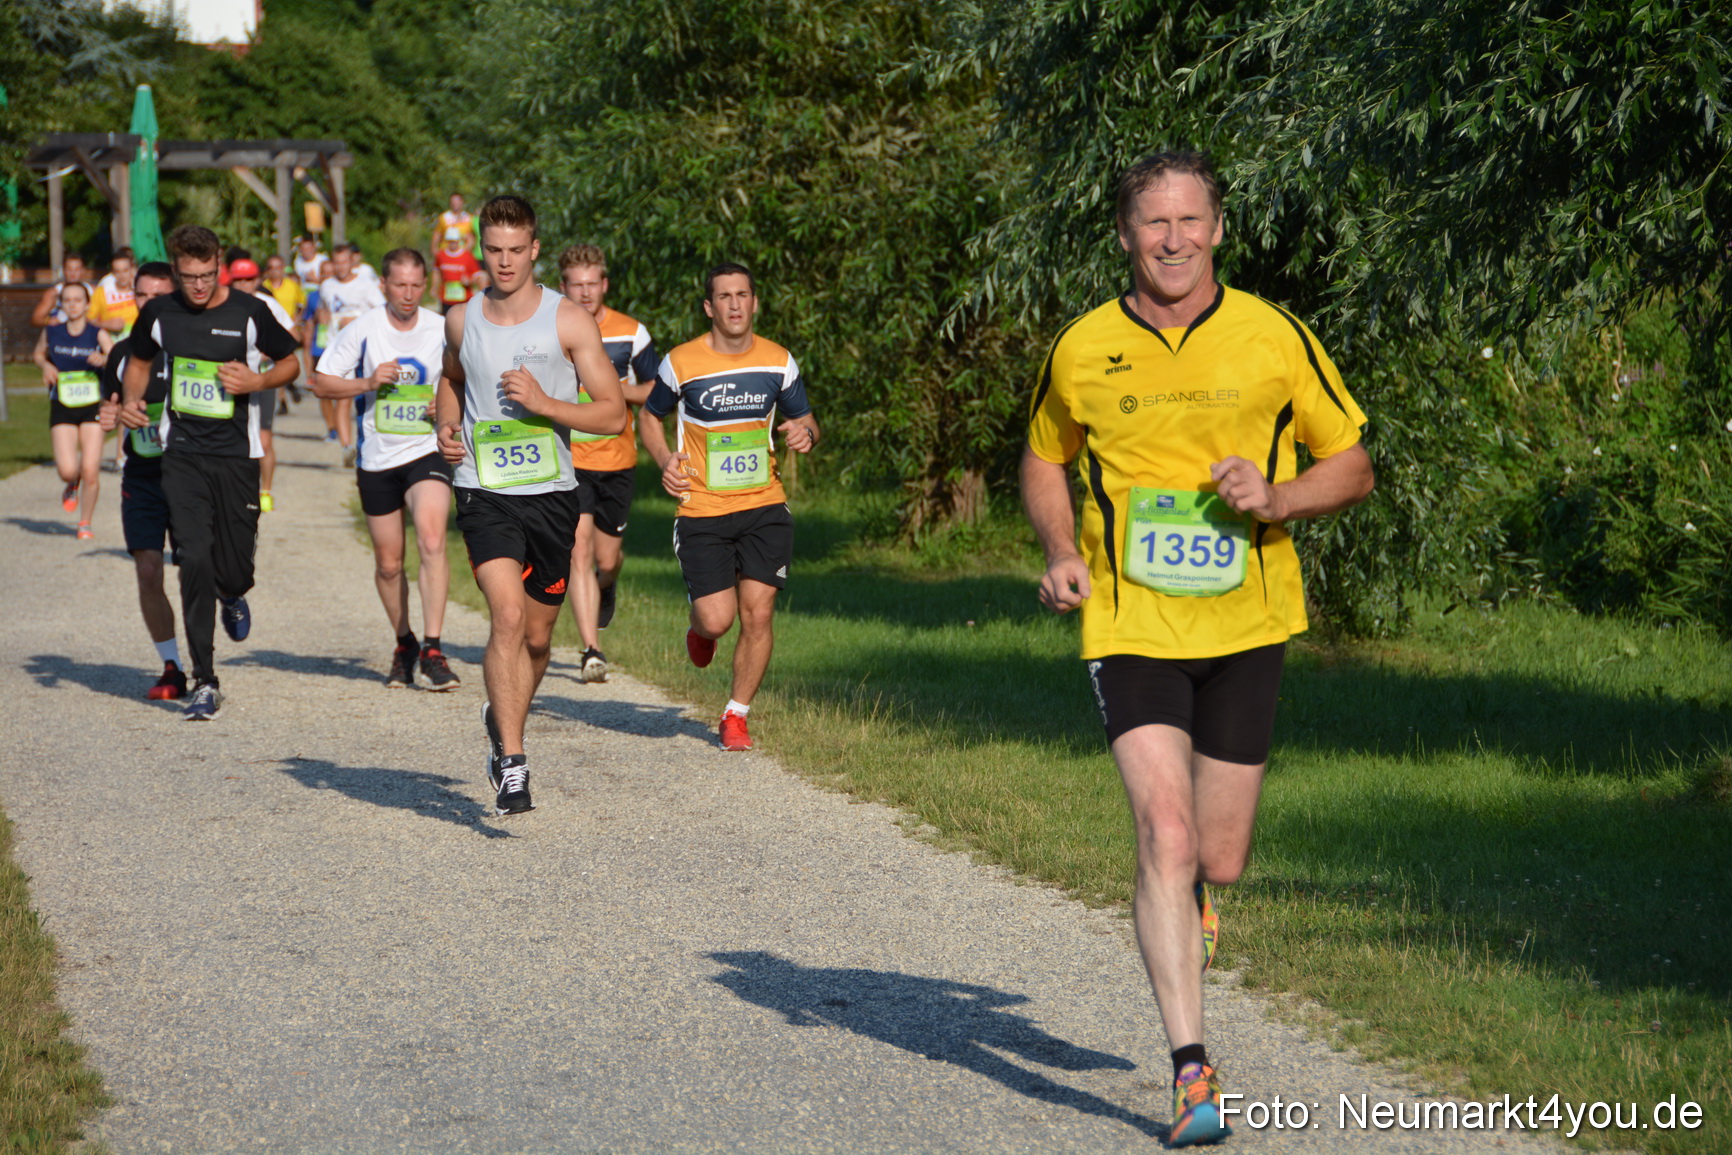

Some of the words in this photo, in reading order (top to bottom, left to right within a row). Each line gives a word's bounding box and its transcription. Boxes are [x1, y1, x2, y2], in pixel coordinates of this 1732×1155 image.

[1105, 364, 1132, 375] erima
[67, 386, 90, 397] 368
[180, 380, 226, 402] 1081
[712, 391, 768, 407] Fischer
[1143, 390, 1239, 407] SPANGLER
[382, 404, 428, 421] 1482
[718, 403, 764, 413] AUTOMOBILE
[493, 443, 541, 468] 353
[720, 454, 758, 474] 463
[1147, 506, 1190, 516] firmenlauf
[1140, 531, 1235, 568] 1359
[1147, 572, 1174, 580] Helmut
[1174, 574, 1222, 582] Graspointner
